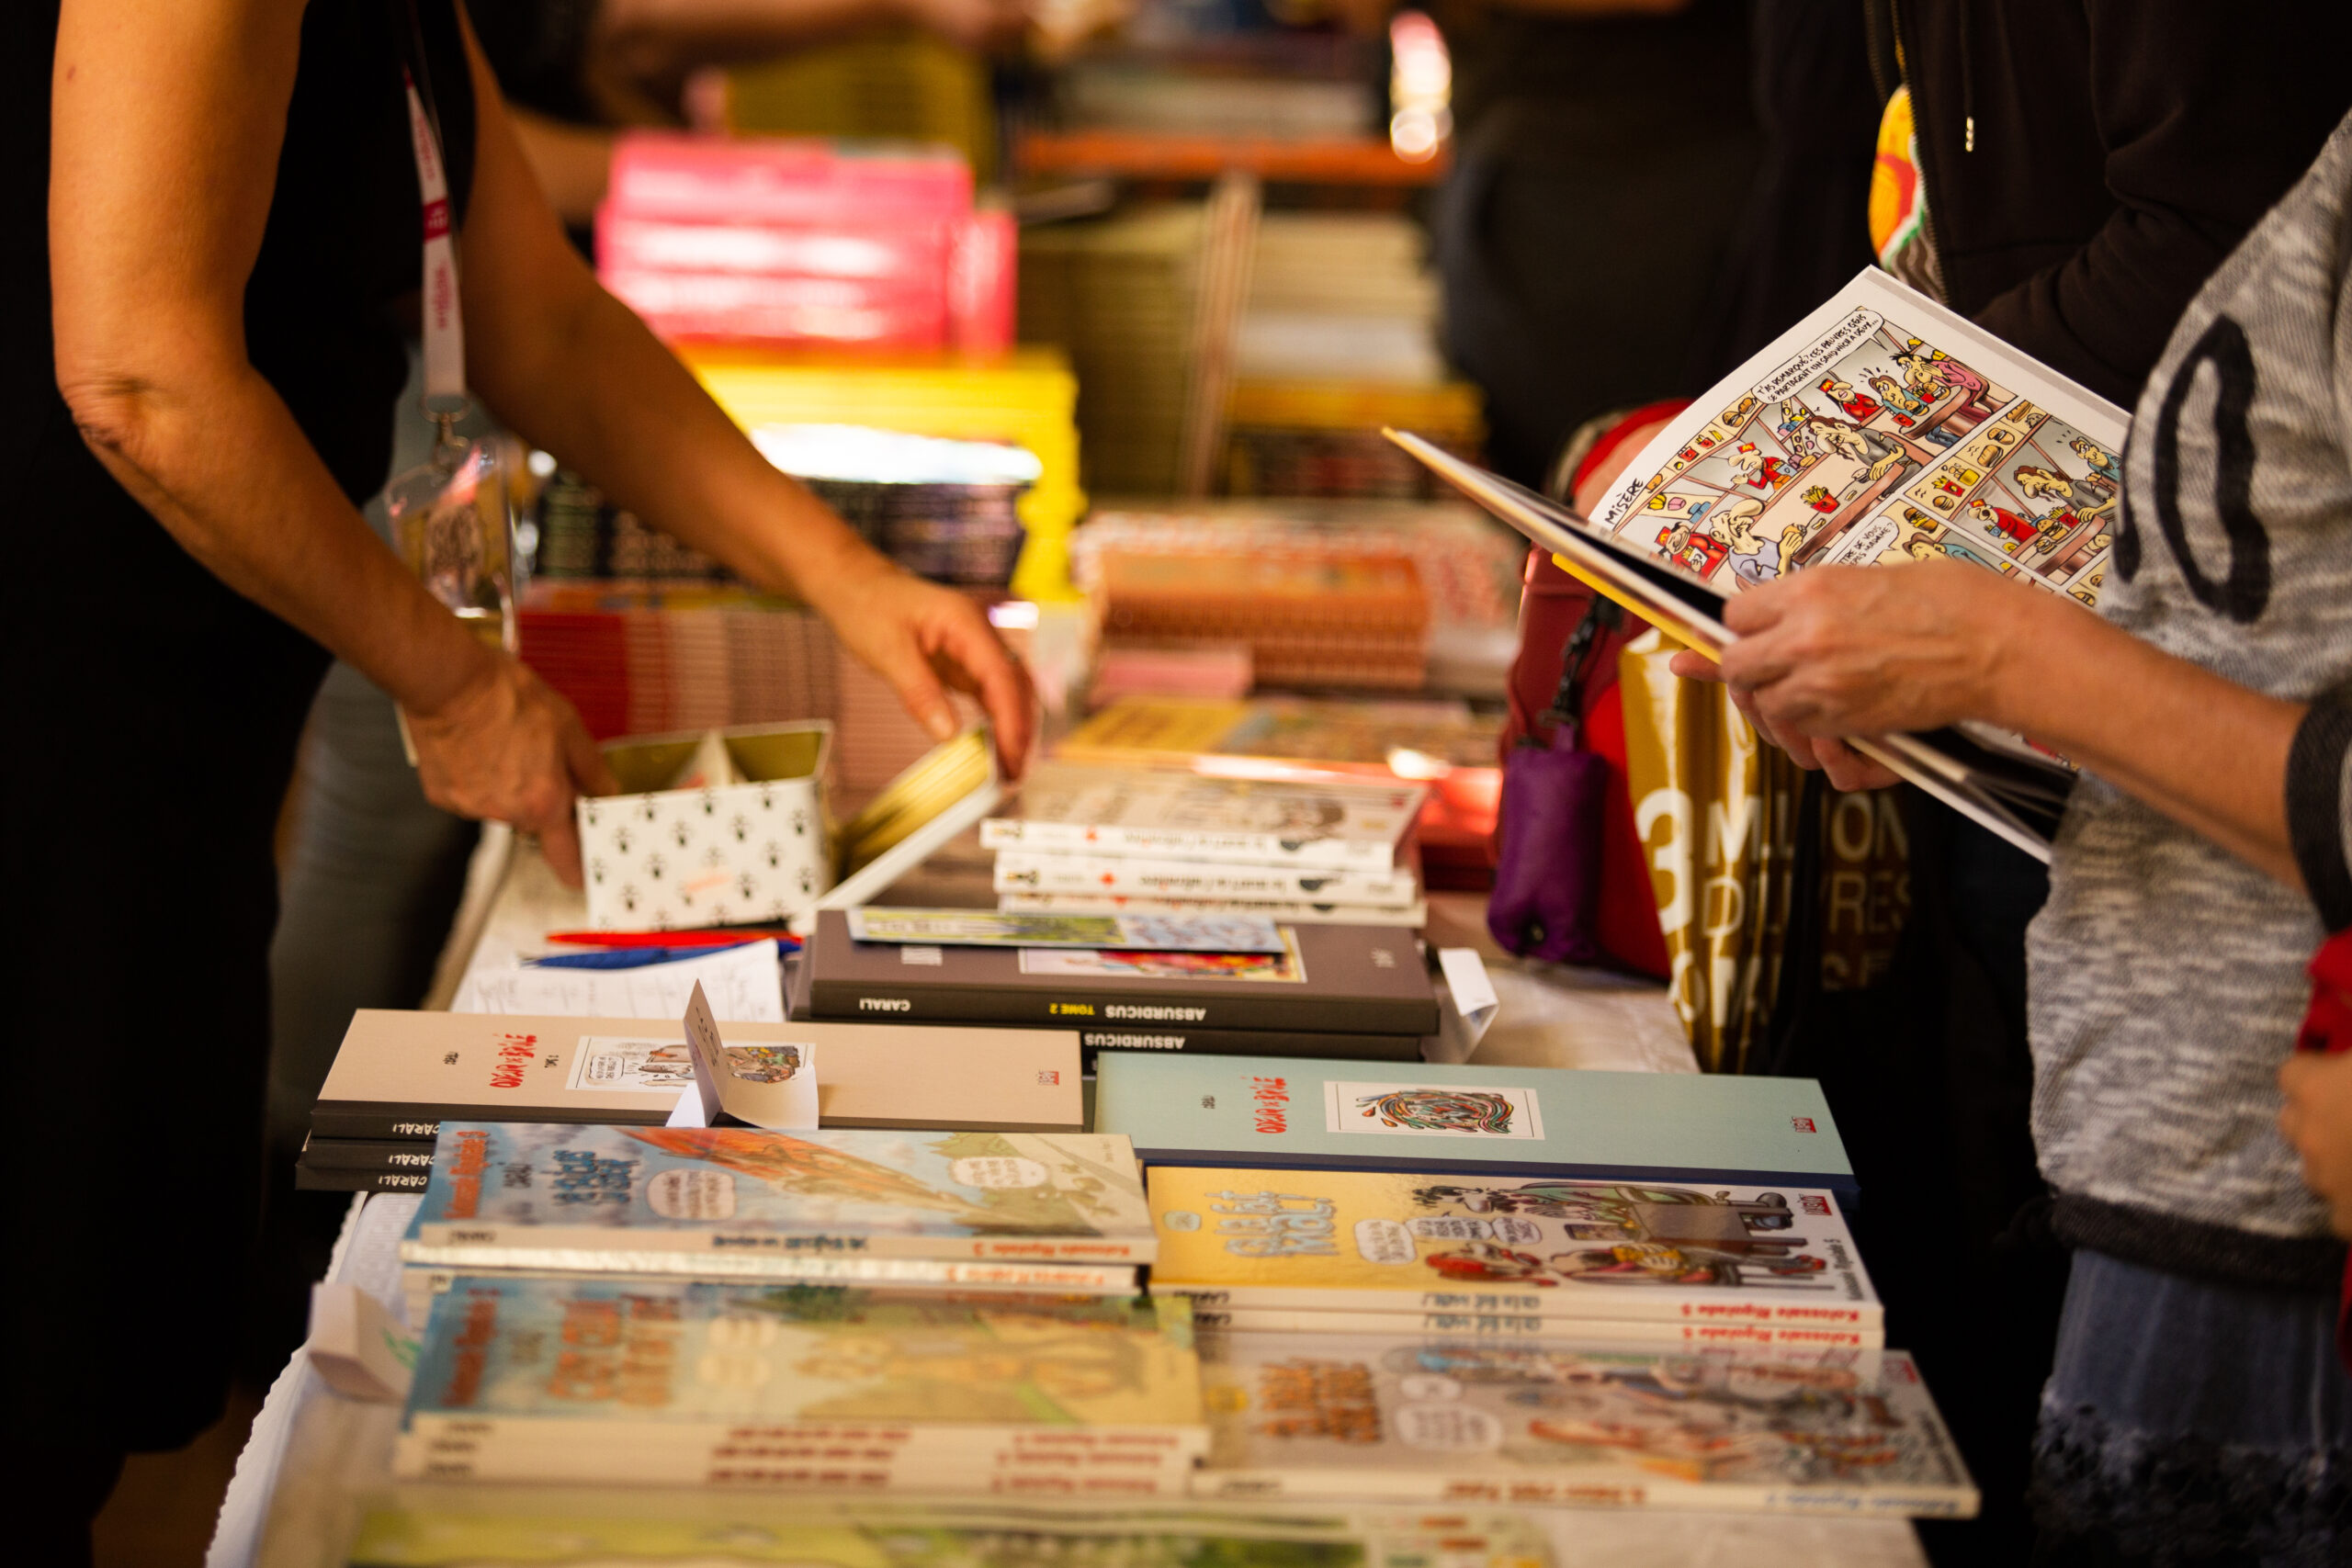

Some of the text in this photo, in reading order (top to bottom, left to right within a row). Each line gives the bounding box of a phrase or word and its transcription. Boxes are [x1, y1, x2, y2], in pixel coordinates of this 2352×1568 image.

[1634, 786, 1693, 936] 3
[858, 997, 911, 1012] CARALI
[1049, 1002, 1206, 1022] ABSURDICUS TOME 2
[1084, 1032, 1185, 1050] ABSURDICUS
[391, 1122, 440, 1135] CARALI
[378, 1175, 428, 1188] CARALI
